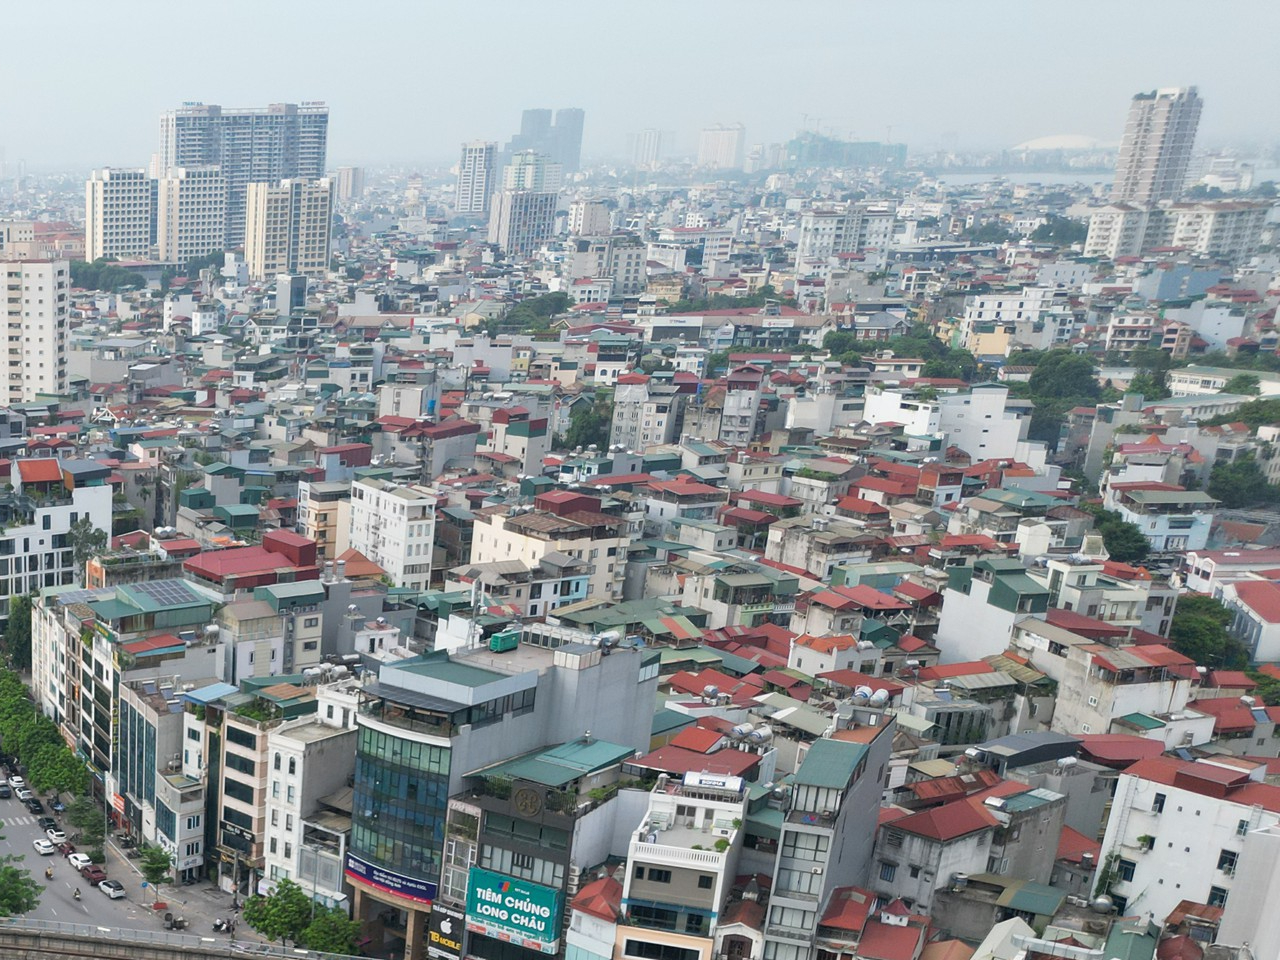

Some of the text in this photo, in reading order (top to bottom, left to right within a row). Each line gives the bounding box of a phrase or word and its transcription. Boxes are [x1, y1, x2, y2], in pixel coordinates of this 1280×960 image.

[476, 887, 550, 918] TIÊM CHỦNG
[476, 903, 509, 921] LONG
[511, 914, 545, 932] CHÂU
[439, 936, 462, 950] MOBILE
